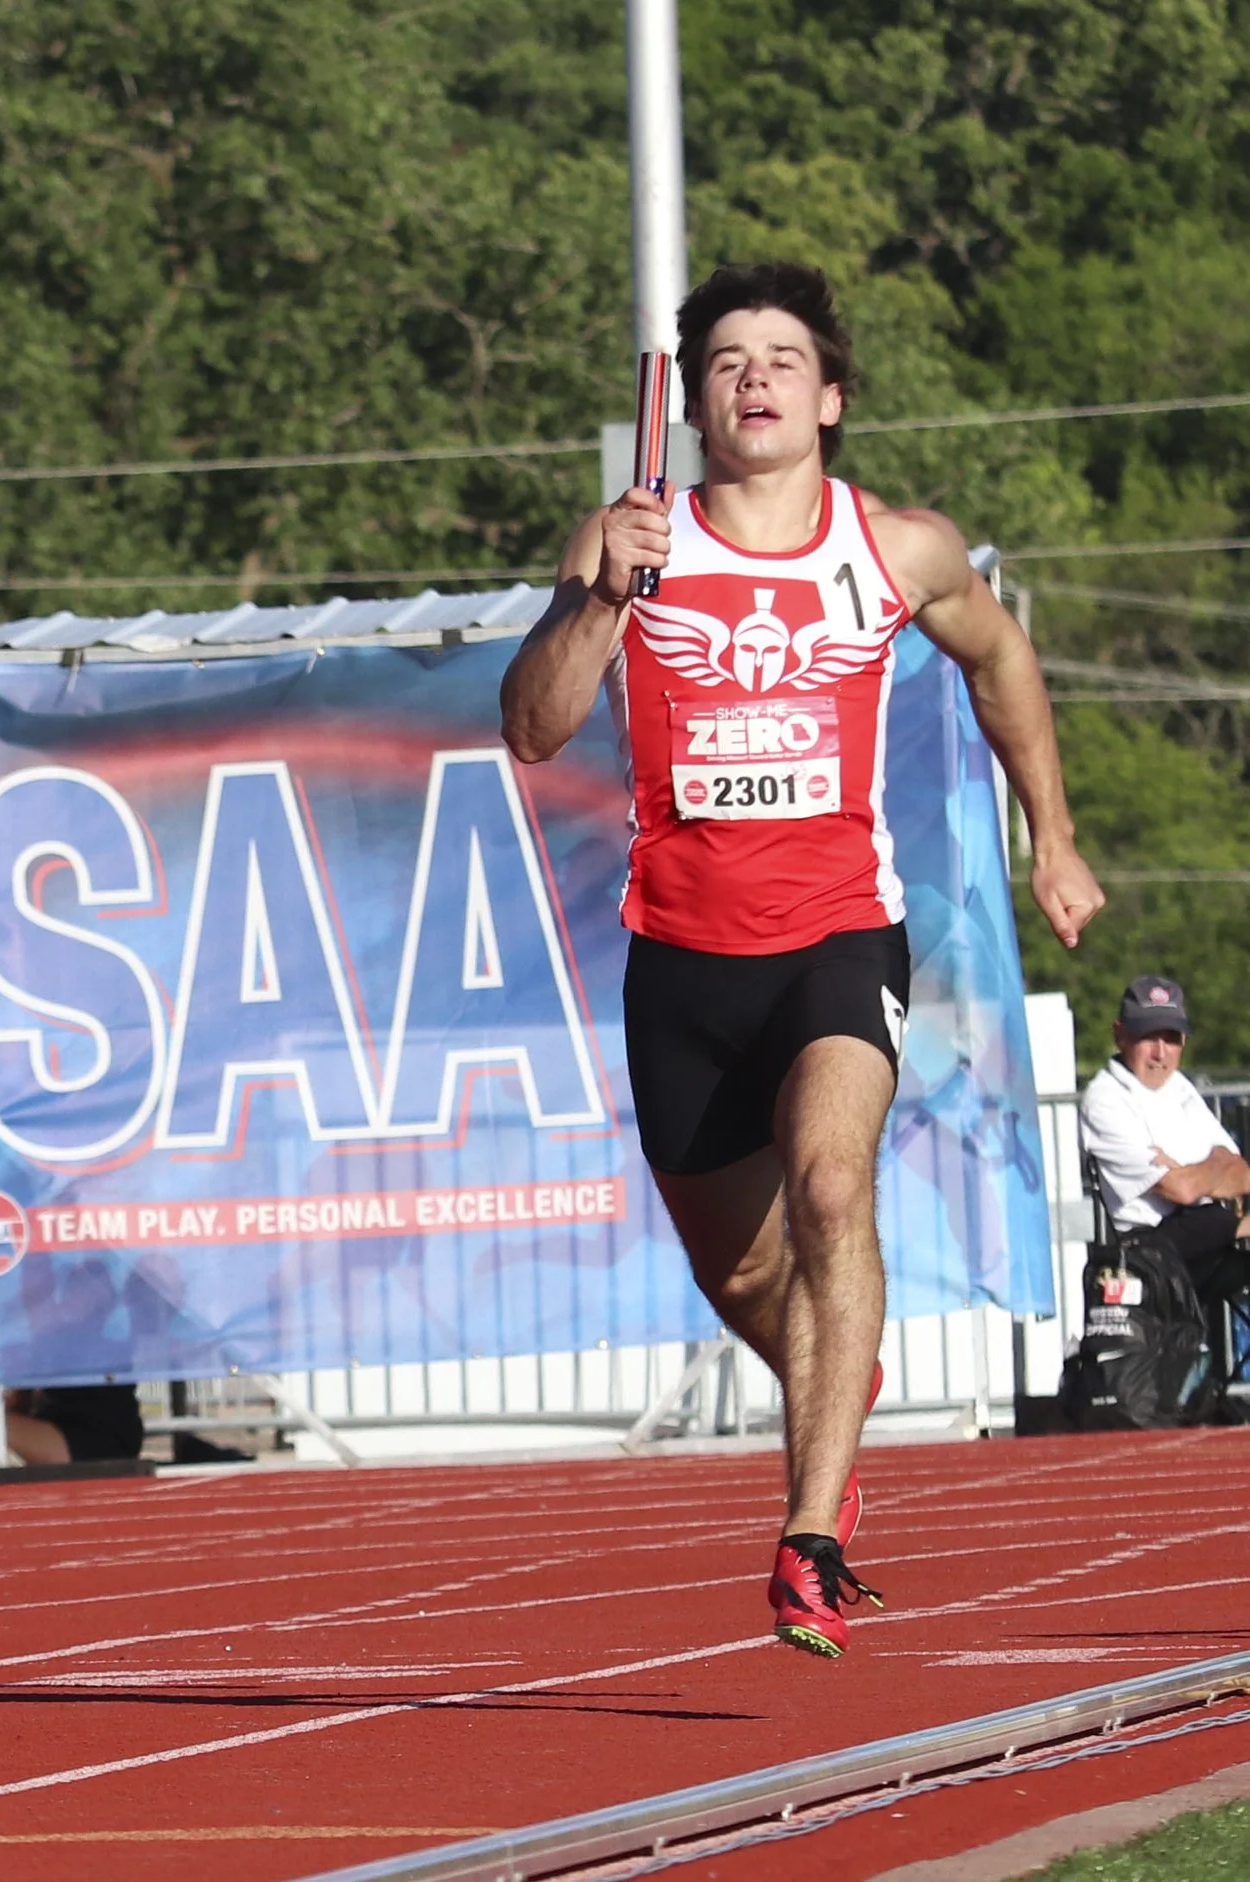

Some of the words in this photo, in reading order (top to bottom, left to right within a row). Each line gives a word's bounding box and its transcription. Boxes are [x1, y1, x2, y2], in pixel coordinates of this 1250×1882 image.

[833, 563, 866, 631] 1
[716, 704, 788, 720] SHOW-ME
[687, 713, 820, 755] ZERO
[713, 774, 796, 807] 2301
[36, 1208, 129, 1244] TEAM
[138, 1205, 226, 1239] PLAY.
[236, 1195, 405, 1235] PERSONAL
[416, 1183, 616, 1225] EXCELLENCE
